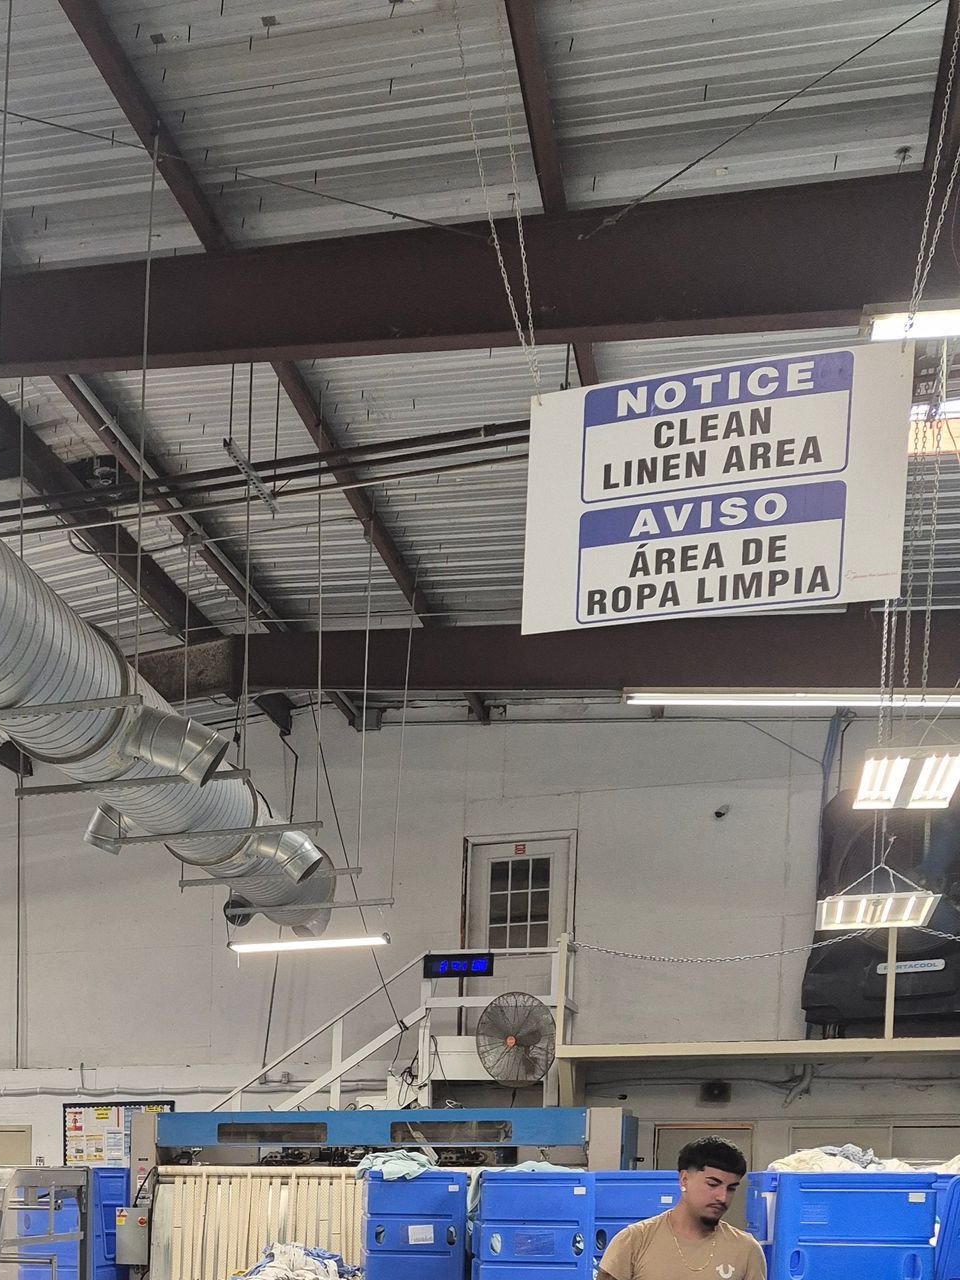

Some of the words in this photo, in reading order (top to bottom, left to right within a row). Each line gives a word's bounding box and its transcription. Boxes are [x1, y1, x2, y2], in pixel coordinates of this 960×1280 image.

[616, 360, 816, 418] NOTICE
[653, 406, 773, 449] CLEAN
[602, 451, 708, 490] LINEN
[722, 435, 823, 475] AREA
[629, 493, 789, 538] AVISO
[629, 542, 725, 579] ÁREA
[741, 534, 788, 566] DE
[586, 579, 681, 616] ROPA
[696, 565, 831, 604] LIMPIA
[883, 962, 938, 971] PRTACOOL
